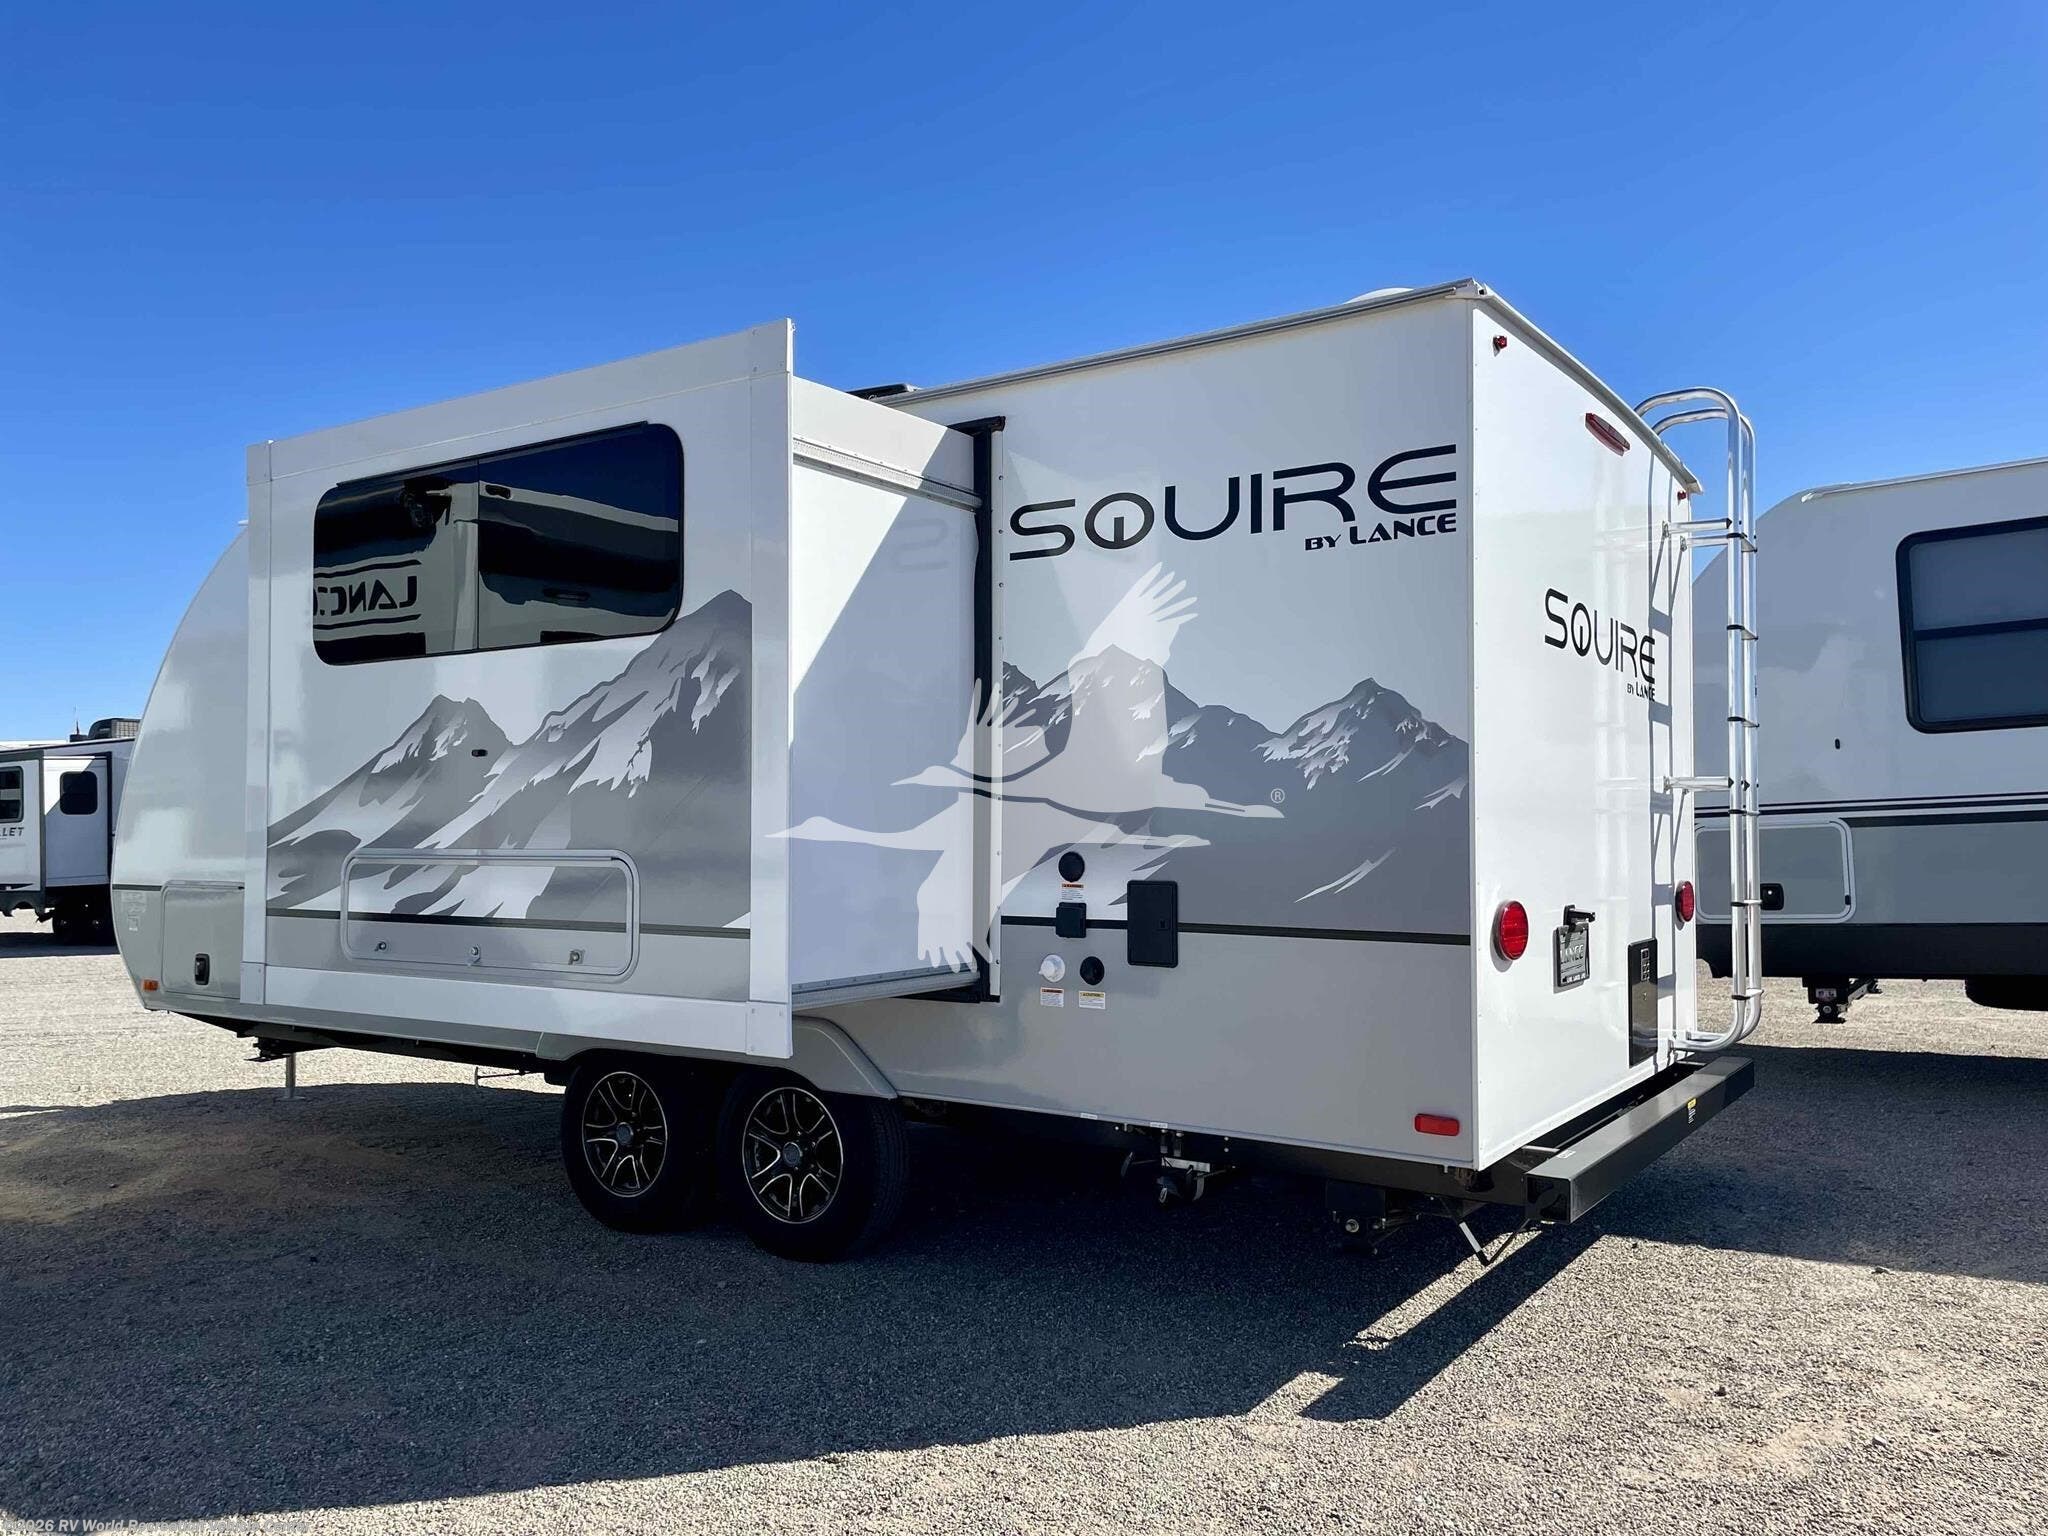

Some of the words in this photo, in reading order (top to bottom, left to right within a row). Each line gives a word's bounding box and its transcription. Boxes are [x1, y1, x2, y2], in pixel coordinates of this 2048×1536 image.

[1009, 443, 1457, 561] SQUIRE
[1304, 533, 1342, 551] BY
[1348, 512, 1457, 545] LANCE
[1544, 587, 1656, 685] SQUIRE
[0, 827, 24, 837] LET
